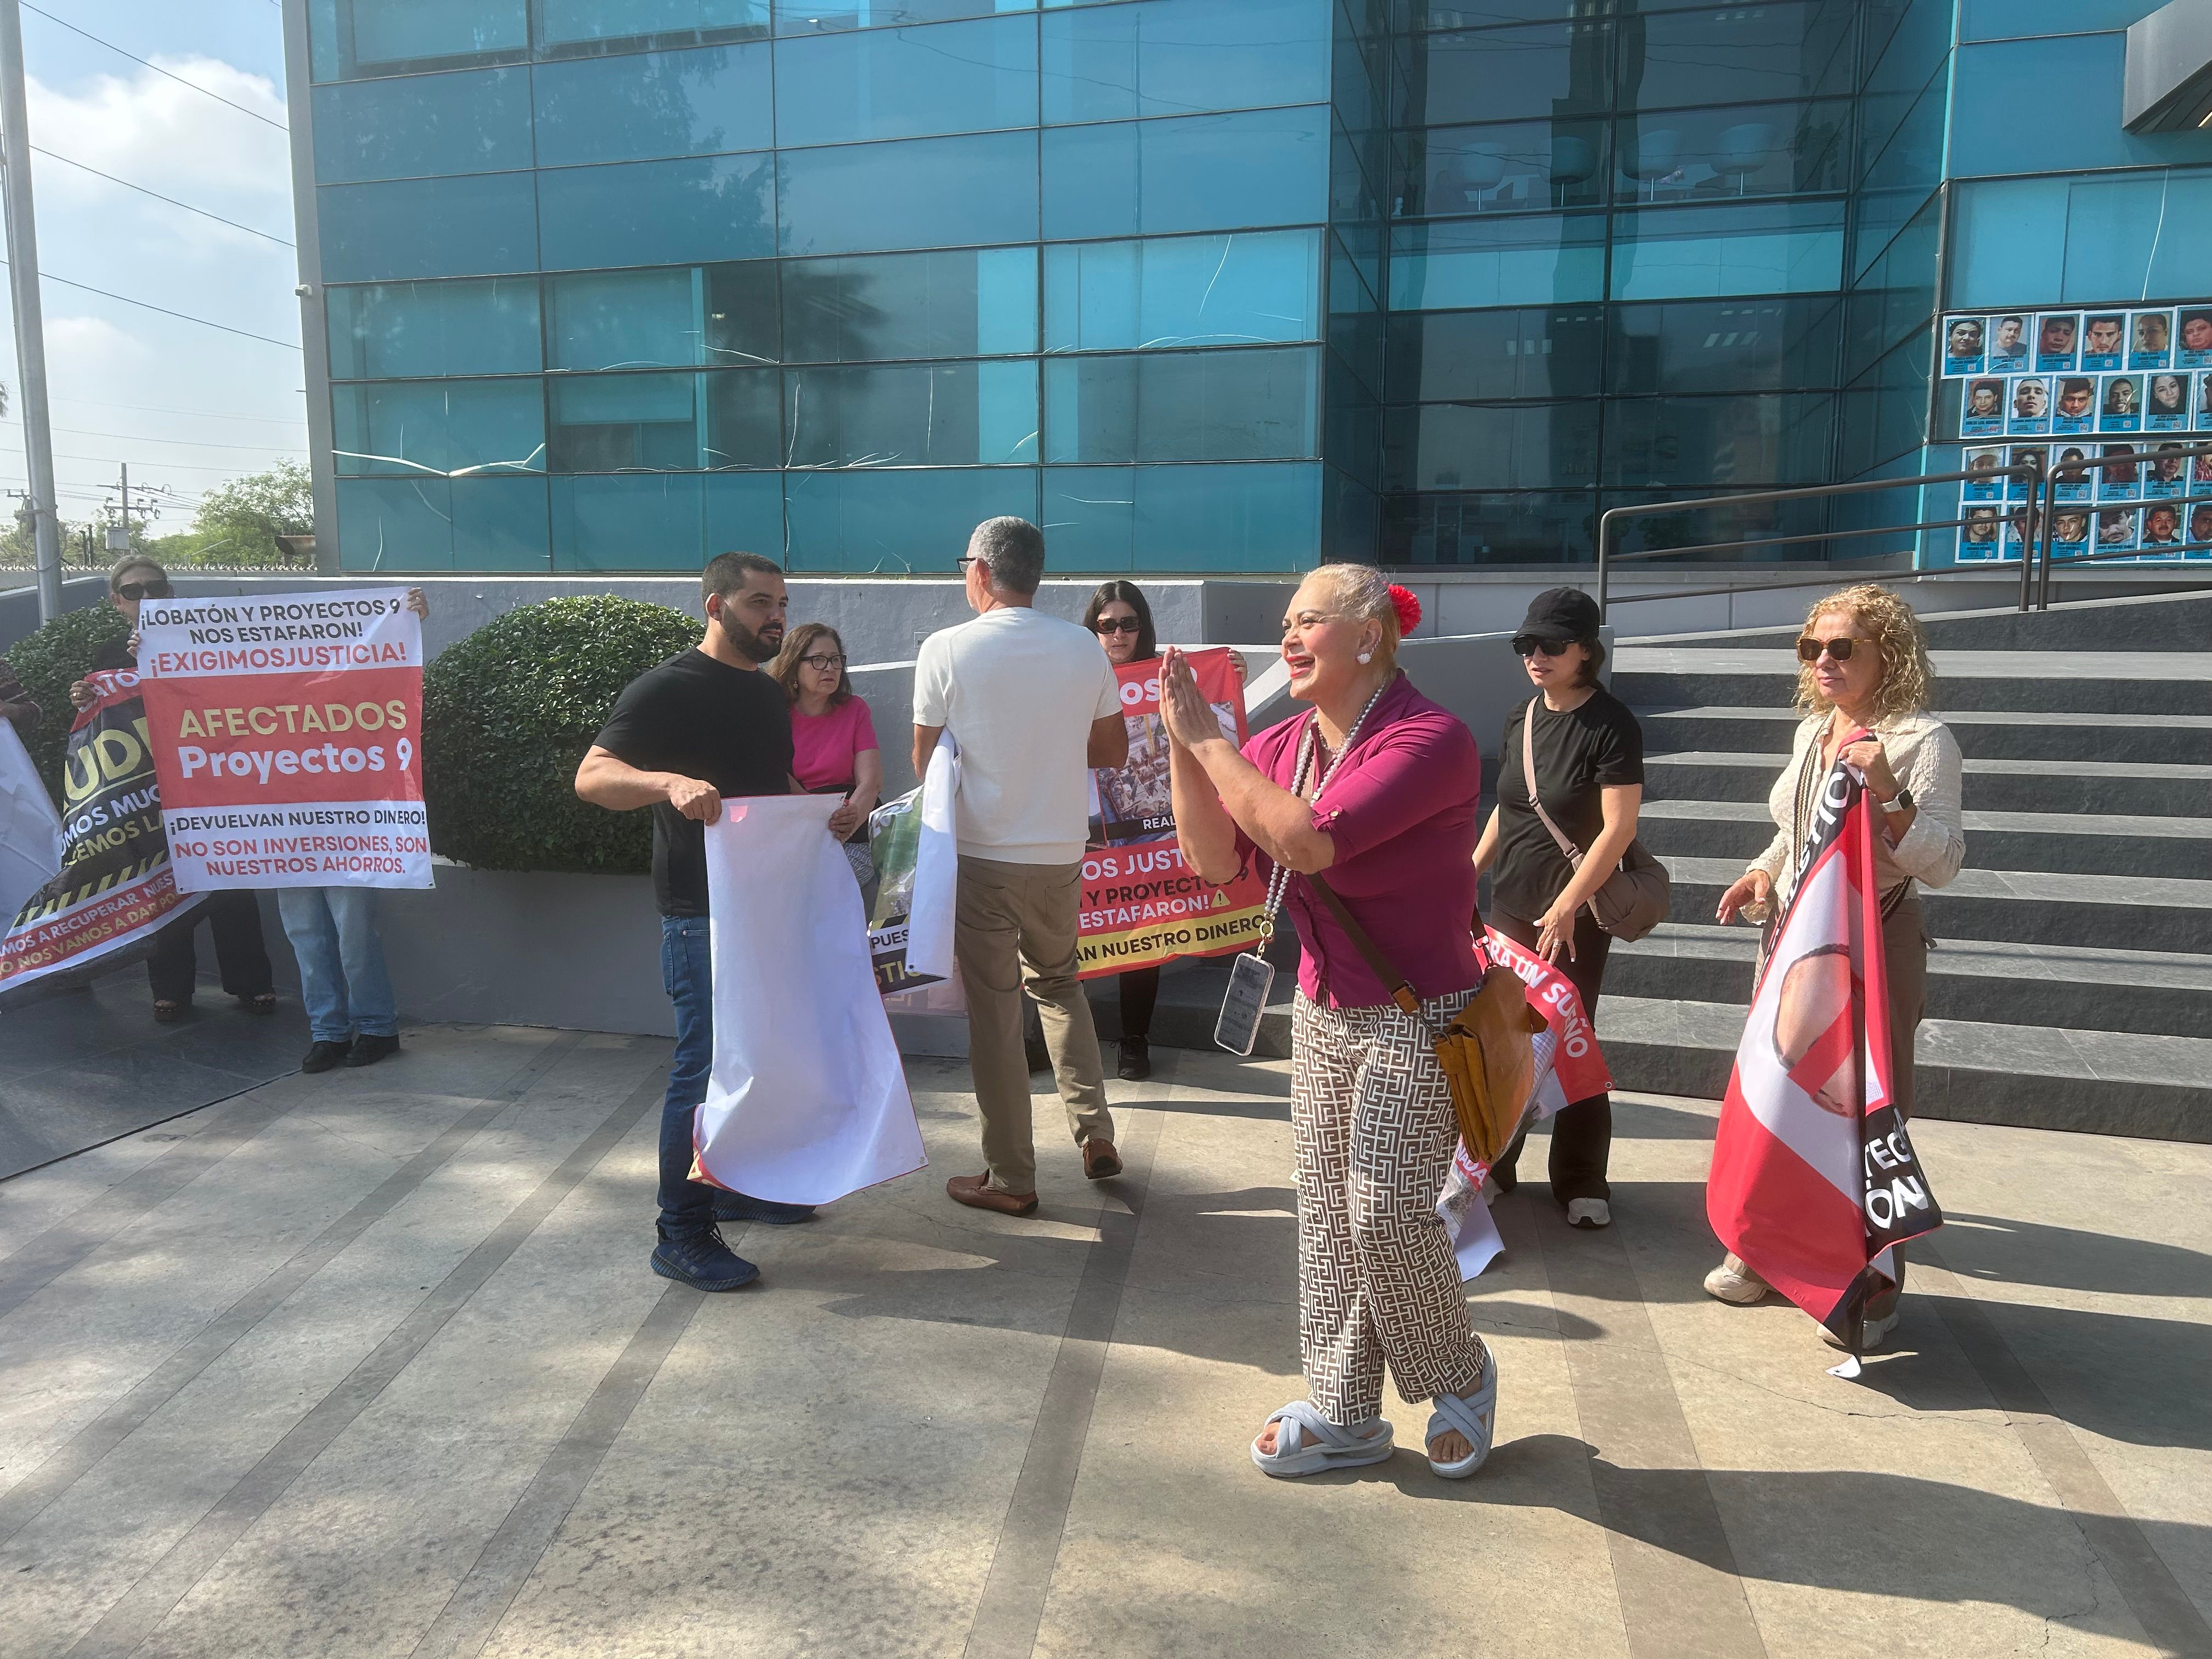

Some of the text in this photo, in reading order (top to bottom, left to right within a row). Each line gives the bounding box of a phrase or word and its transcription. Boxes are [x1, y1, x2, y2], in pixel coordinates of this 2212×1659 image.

[141, 598, 400, 630] ¡LOBATÓN Y PROYECTOS 9
[189, 622, 363, 645] NOS ESTAFARON!
[1119, 678, 1160, 705] OS
[179, 699, 407, 738] AFECTADOS
[177, 737, 413, 785] Proyectos 9
[110, 783, 161, 818] MUC
[170, 809, 426, 836] ¡DEVUELVAN NUESTRO DINERO!
[1142, 815, 1176, 830] REAL
[174, 836, 427, 859] NO SON INVERSIONES, SON
[206, 856, 406, 877] NUESTROS AHORROS.
[1082, 848, 1184, 881] OS JUST
[1105, 874, 1233, 904] PROYECT
[0, 871, 174, 957] MOS A RECUPERAR NUES
[1079, 894, 1209, 929] ESTAFARON!
[0, 961, 14, 973] O
[17, 947, 53, 968] NOS
[52, 922, 113, 955] VAMOS
[114, 917, 127, 930] A
[127, 902, 159, 924] DAR
[870, 929, 909, 949] PUES
[1076, 945, 1097, 961] AN
[1102, 929, 1191, 958] NUESTRO
